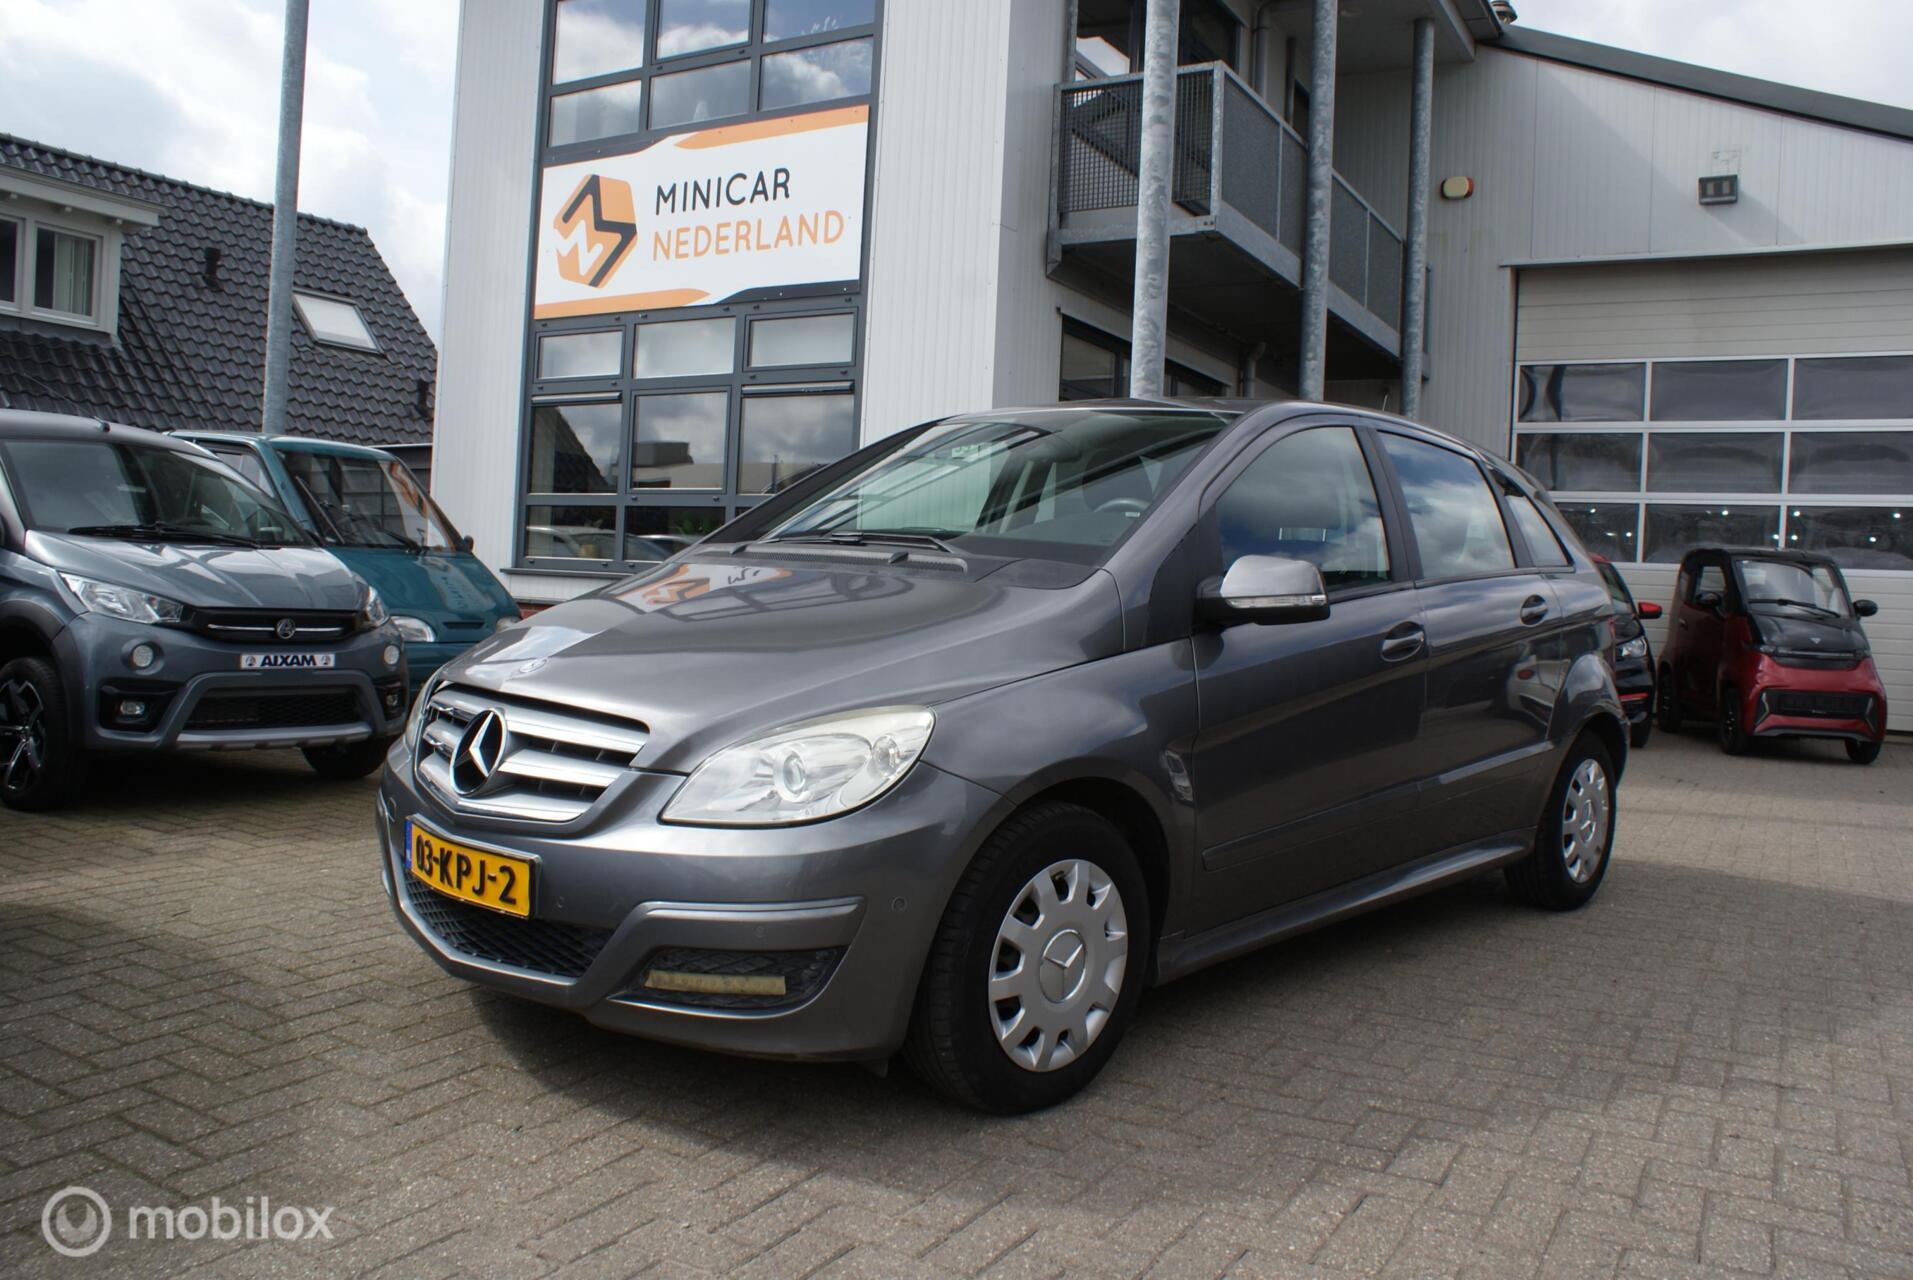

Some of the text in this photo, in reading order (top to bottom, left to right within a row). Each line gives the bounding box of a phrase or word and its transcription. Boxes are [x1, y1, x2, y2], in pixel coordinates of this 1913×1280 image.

[655, 168, 790, 215] MINICAR
[653, 210, 844, 261] NEDERLAND
[261, 655, 316, 666] AIXAM
[416, 834, 517, 904] 03-KPJ-2
